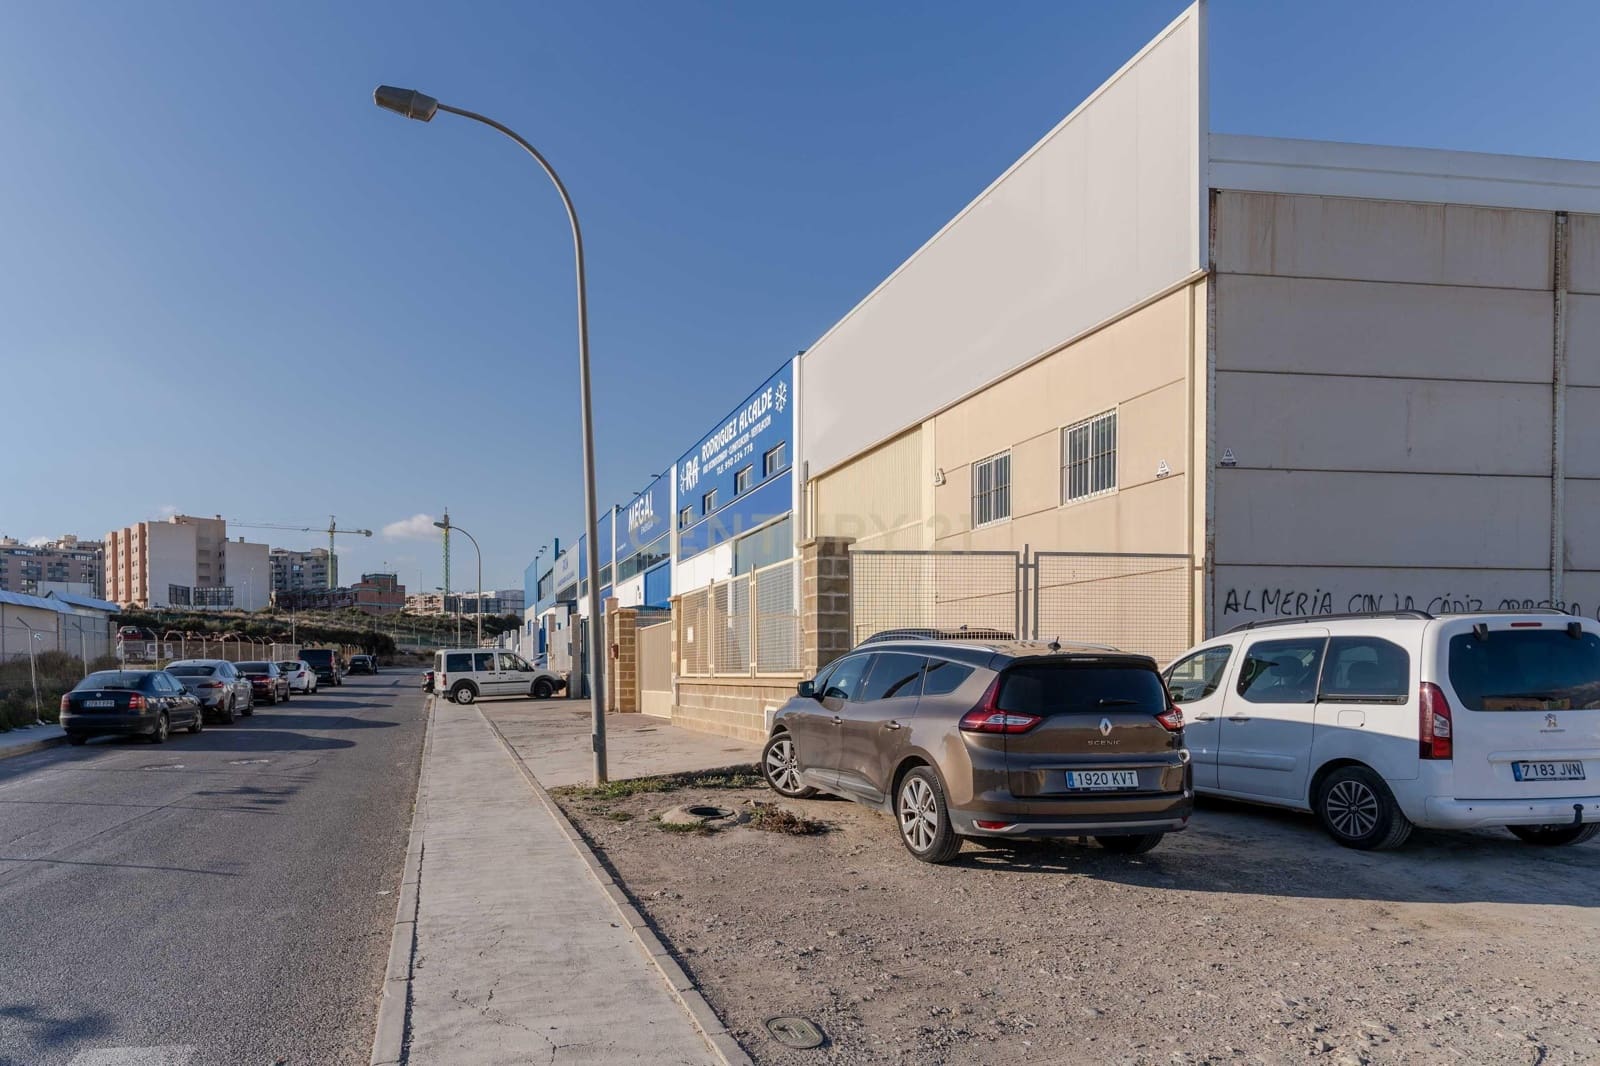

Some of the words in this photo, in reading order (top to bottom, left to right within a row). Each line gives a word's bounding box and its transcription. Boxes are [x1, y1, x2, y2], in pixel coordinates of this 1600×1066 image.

[739, 387, 773, 433] ALCALDE
[1522, 764, 1556, 777] 7183
[1560, 763, 1581, 776] JVN
[1078, 773, 1109, 785] 1920
[1112, 772, 1134, 785] KVT
